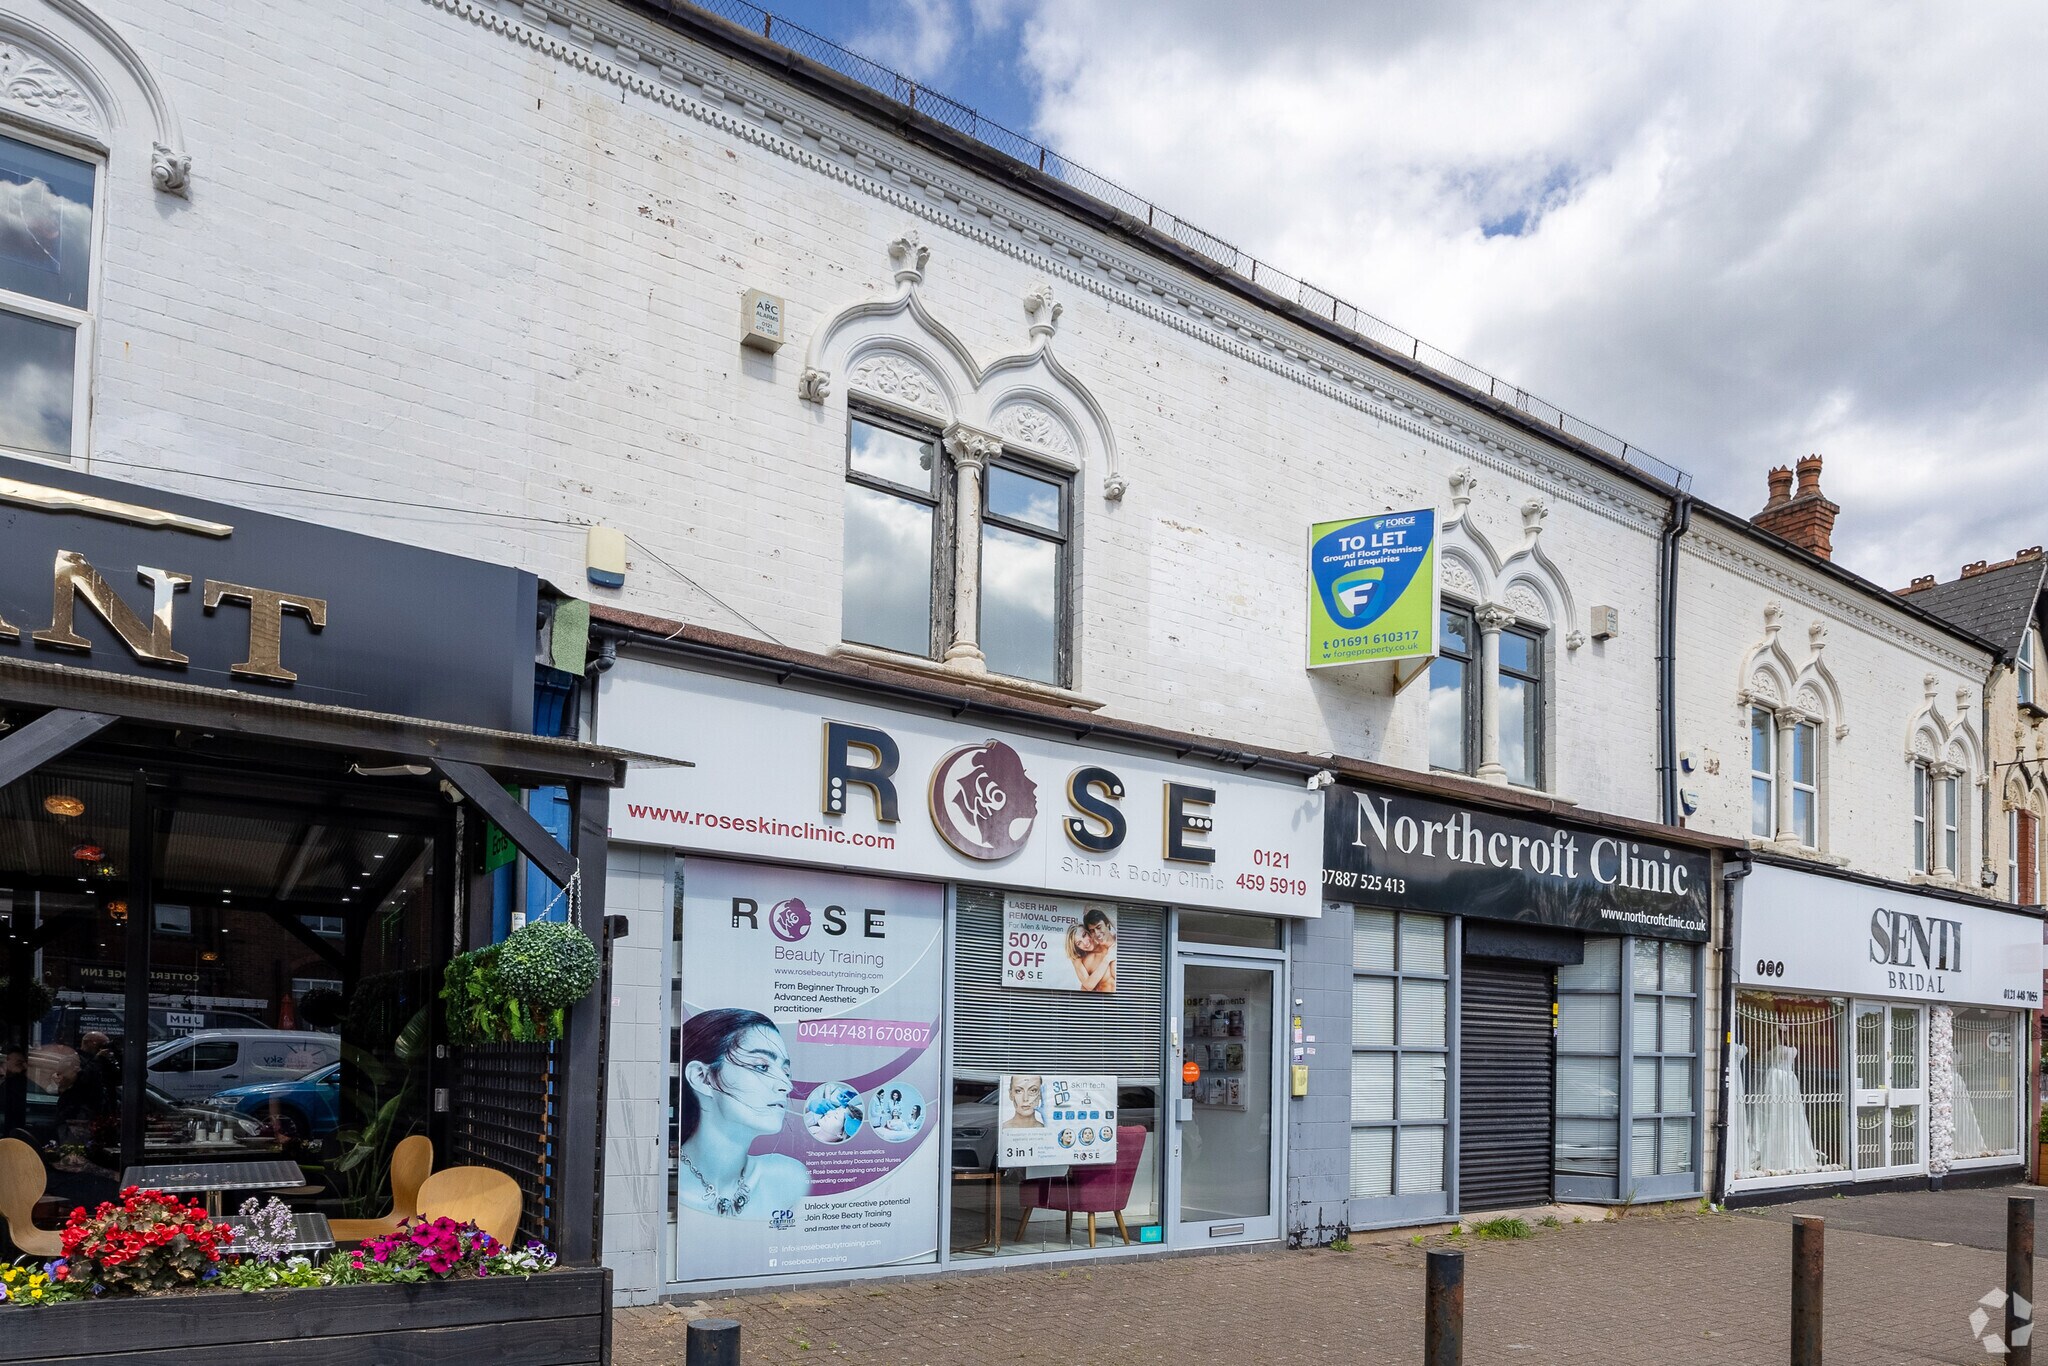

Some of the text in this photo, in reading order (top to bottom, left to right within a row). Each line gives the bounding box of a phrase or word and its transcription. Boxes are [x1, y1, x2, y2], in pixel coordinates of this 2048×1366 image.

[757, 302, 778, 315] ARC
[756, 311, 778, 322] ALARMS
[1386, 516, 1416, 527] FORGE
[1339, 531, 1406, 552] TO LET
[1323, 545, 1422, 563] Ground Floor Premises
[1344, 555, 1400, 568] All Enquiries
[0, 549, 327, 681] NT
[1323, 630, 1418, 650] t 01691 610317
[1334, 642, 1418, 658] forgeproperty.co.uk
[627, 804, 895, 850] www.roseskinclinic.com
[1352, 791, 1688, 896] Northcroft Clinic
[1254, 850, 1290, 868] 0121
[1061, 856, 1224, 890] Skin & Body Clinic
[1236, 873, 1306, 896] 459 5919
[1360, 874, 1382, 890] 525
[1384, 878, 1406, 894] 413
[1009, 902, 1058, 912] LASER HAIR
[1009, 912, 1078, 924] REMOVAL OFFER!
[1600, 908, 1706, 932] www.northcroftclinic.co.uk
[1042, 924, 1064, 932] Women
[1009, 932, 1048, 950] 50%
[774, 946, 884, 968] Beauty Training
[1008, 951, 1046, 968] OFF
[774, 968, 884, 980] www.rosebeautytraining.com
[774, 982, 880, 994] From Beginner Through To
[1888, 971, 1944, 993] BRIDAL
[774, 993, 856, 1003] Advanced Aesthetic
[1184, 997, 1246, 1006] OSE Treatments
[774, 1004, 822, 1013] practitioner
[799, 1022, 930, 1042] 00447481670807
[1007, 1148, 1013, 1158] 3
[1016, 1148, 1025, 1156] in
[1028, 1148, 1033, 1156] 1
[805, 1198, 910, 1210] Unlock your creative potential
[772, 1210, 793, 1220] CPD
[864, 1210, 892, 1218] Training
[782, 1255, 847, 1266] rosebeautytraining
